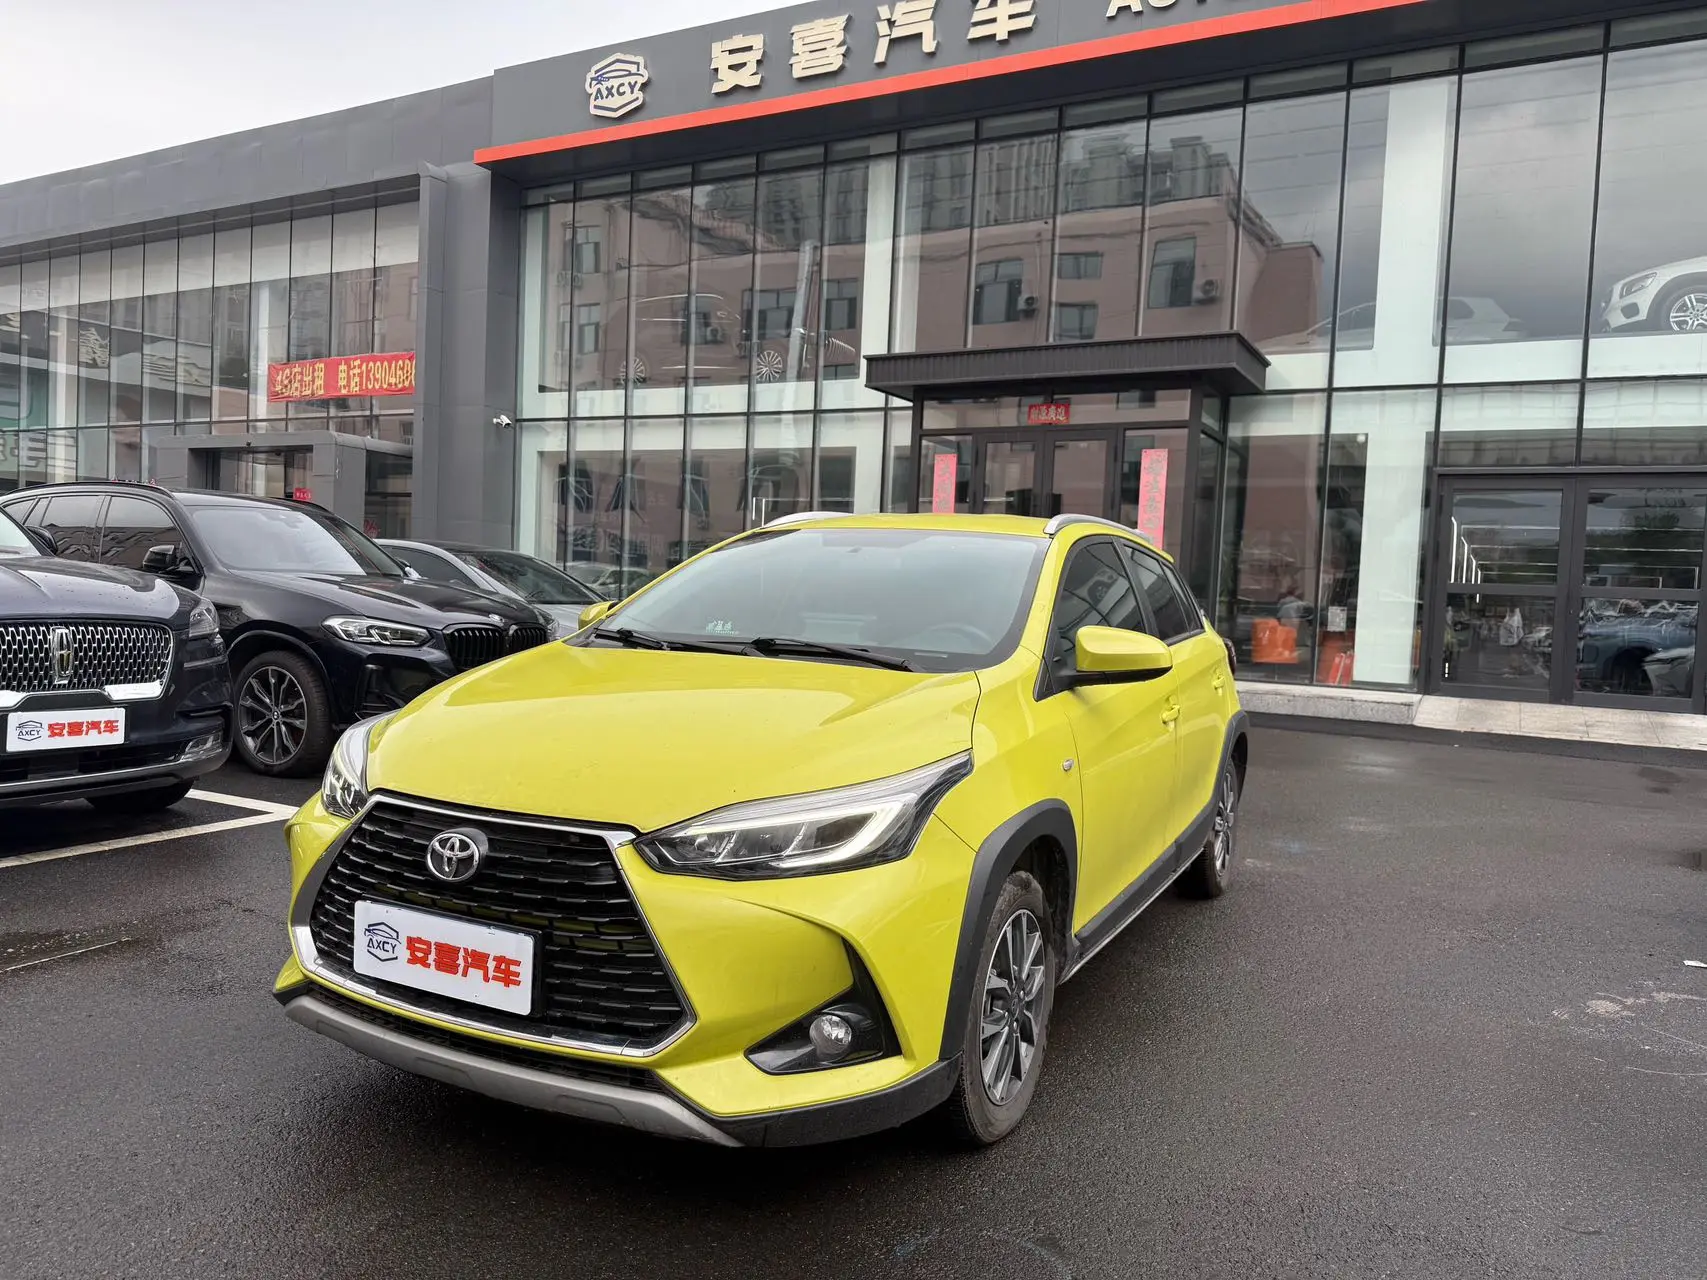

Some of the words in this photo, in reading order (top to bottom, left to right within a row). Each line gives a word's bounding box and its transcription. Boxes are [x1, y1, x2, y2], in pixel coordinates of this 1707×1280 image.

[710, 0, 1037, 94] 安喜汽车
[594, 81, 638, 101] AXCY
[275, 363, 325, 397] 4S店出租
[18, 729, 41, 737] AXCY
[48, 720, 119, 738] 安喜汽车
[367, 937, 397, 954] AXCY
[406, 936, 522, 988] 安喜汽车
